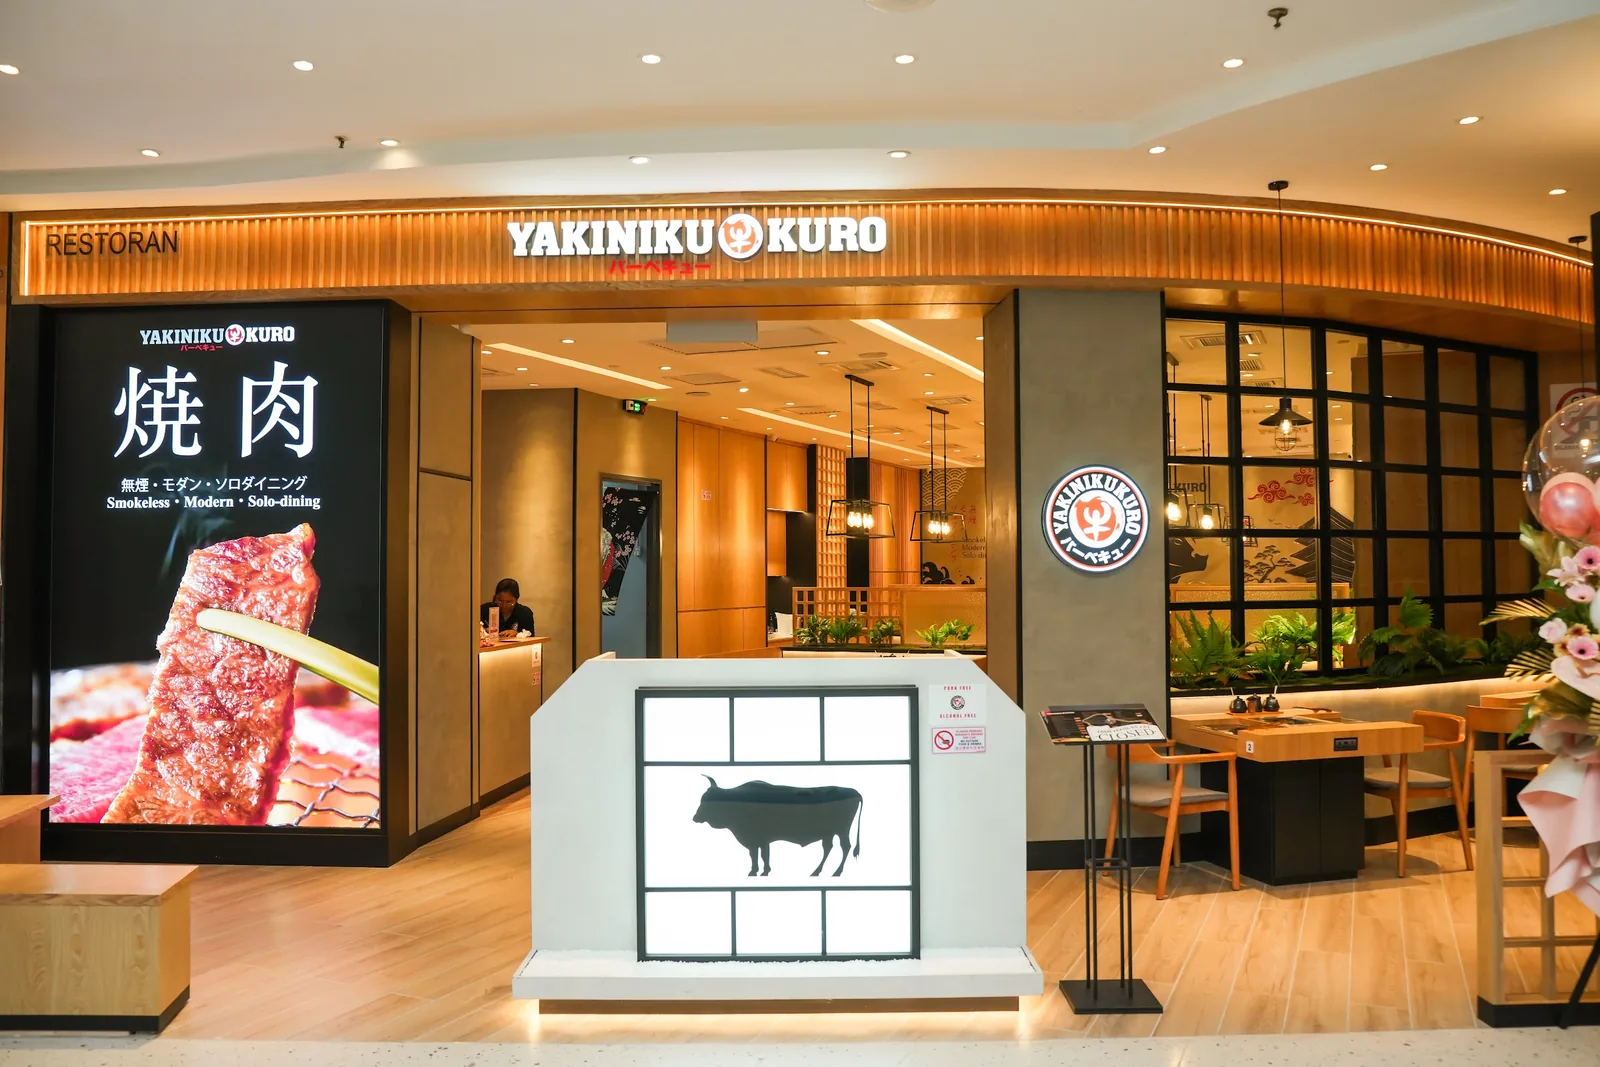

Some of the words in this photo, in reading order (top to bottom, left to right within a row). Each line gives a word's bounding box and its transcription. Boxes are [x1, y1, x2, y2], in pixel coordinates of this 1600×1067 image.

[46, 230, 178, 256] RESTORAN
[507, 218, 714, 256] YAKINIKU
[766, 216, 887, 253] KURO
[608, 259, 712, 275] バーベキュー
[140, 327, 225, 345] YAKINIKU
[246, 326, 295, 342] KURO
[106, 496, 170, 508] Smokeless
[183, 496, 234, 508] Modern
[247, 495, 321, 510] Solo-dining
[1060, 537, 1132, 565] バーベキュー
[1098, 727, 1155, 741] CLOSED
[1248, 743, 1252, 751] 2
